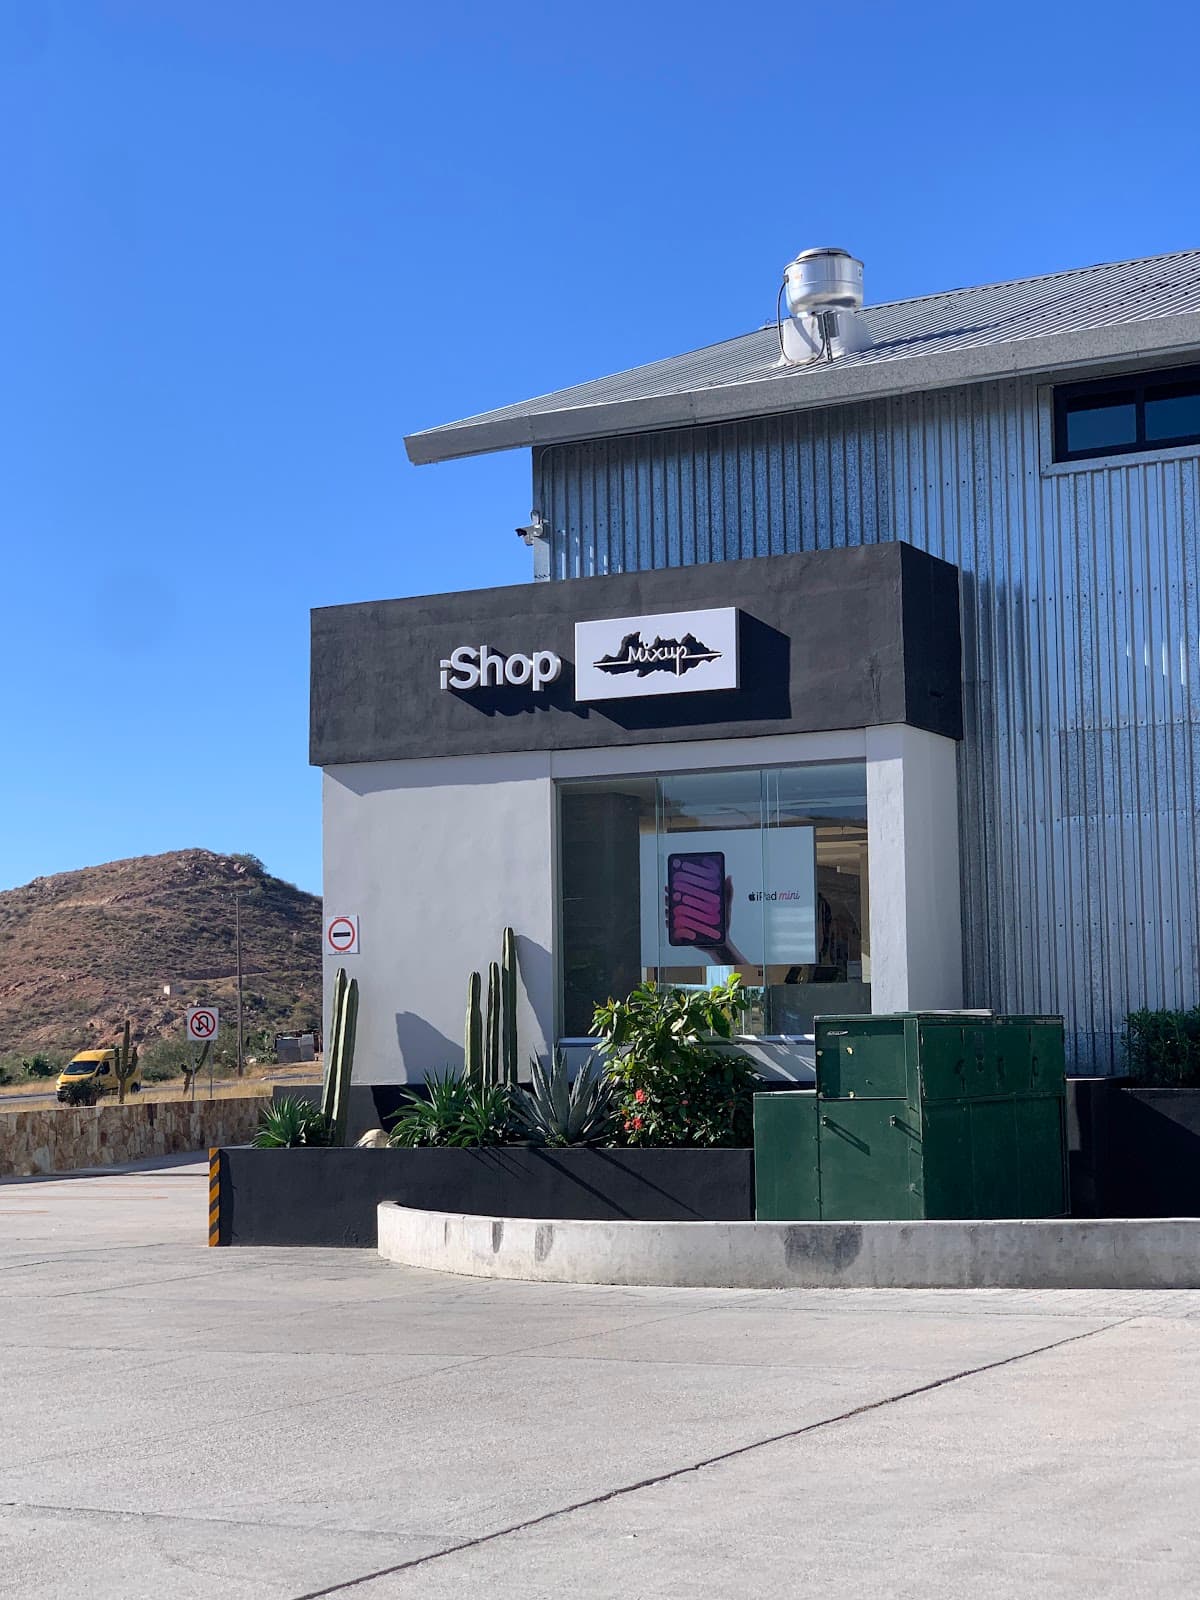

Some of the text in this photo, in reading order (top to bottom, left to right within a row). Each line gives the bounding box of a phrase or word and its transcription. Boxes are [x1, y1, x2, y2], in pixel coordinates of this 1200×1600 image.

[439, 644, 561, 692] iShop
[627, 642, 688, 678] Mixup
[778, 889, 801, 901] mini
